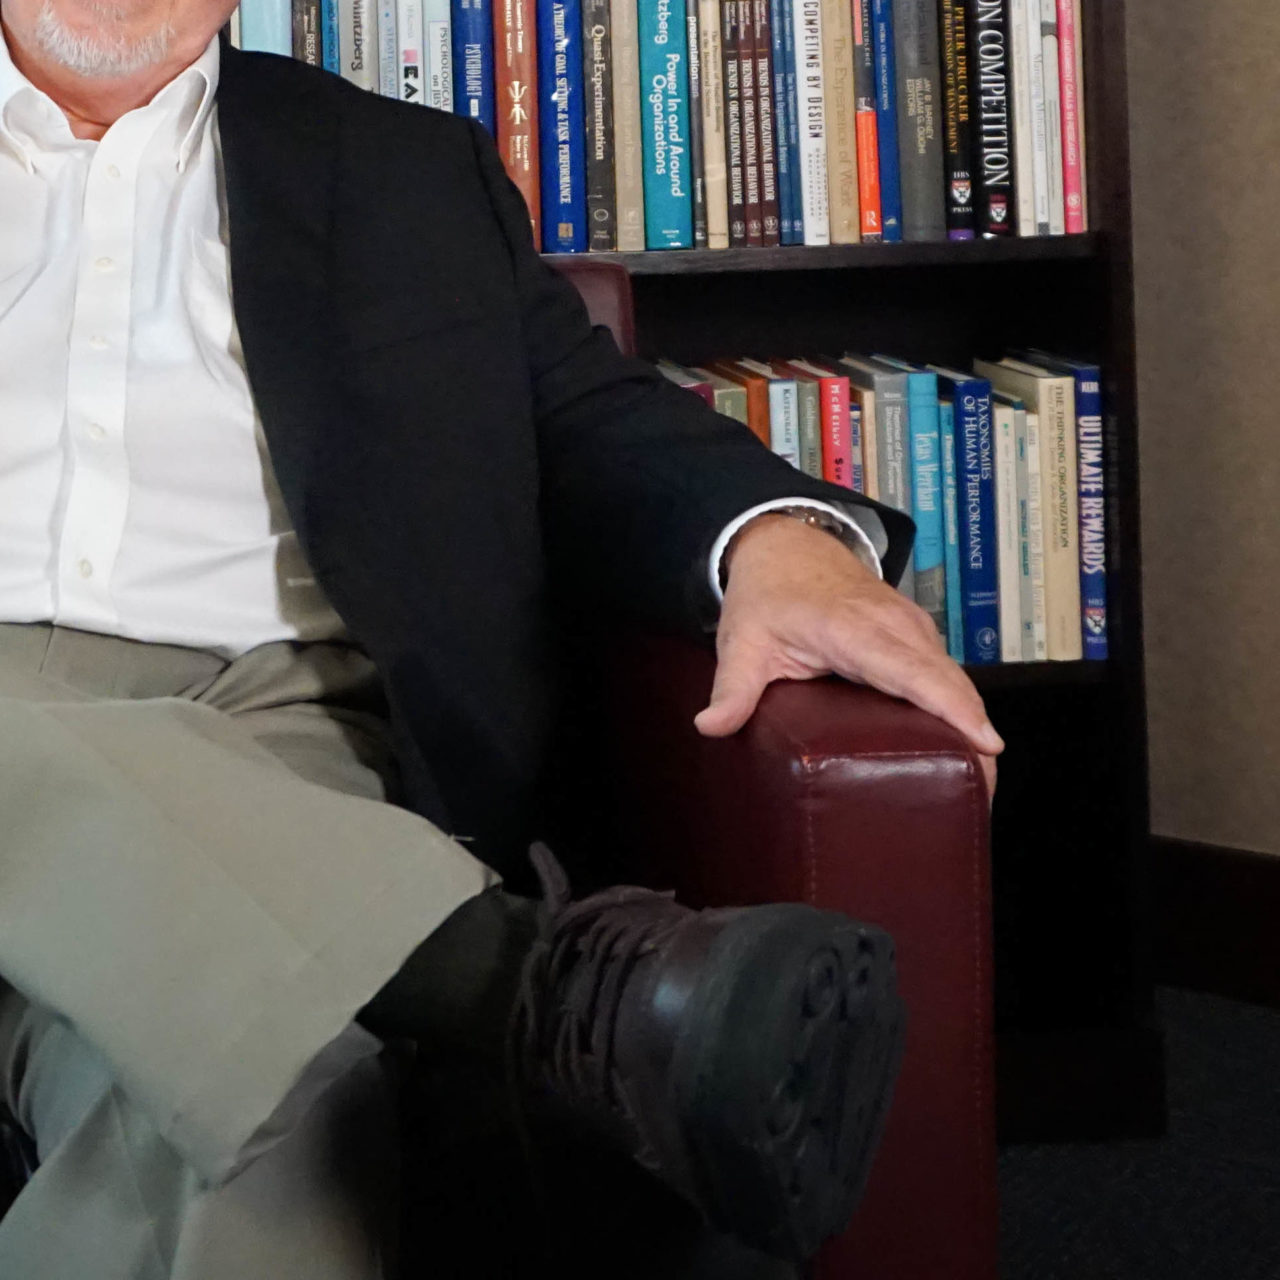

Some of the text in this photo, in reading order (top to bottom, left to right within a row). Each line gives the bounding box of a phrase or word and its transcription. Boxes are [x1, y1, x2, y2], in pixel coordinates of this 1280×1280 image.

[465, 44, 482, 96] PSYCHOLOGY
[554, 9, 566, 42] THEORY
[556, 55, 568, 75] GOAL
[804, 2, 822, 138] COMPETING BY DESIGN
[955, 7, 968, 122] PETER DRUCKER
[557, 78, 568, 111] SETTING
[558, 120, 569, 141] TASK
[592, 24, 605, 160] Quasi-Experimentation
[650, 75, 667, 174] Organizations
[666, 54, 684, 196] Power In and Around
[759, 58, 775, 200] TRENDS IN ORGANIZATIONAL BEHAVIOR
[834, 36, 851, 206] The Experience of Work
[979, 30, 1010, 185] COMPETITION
[559, 144, 570, 203] PERFORMANCE
[806, 396, 815, 438] Goldman
[978, 395, 991, 479] TAXONOMIES
[1055, 386, 1069, 547] THE THINKING ORGANIZATION
[915, 432, 939, 511] Texas Merchant
[963, 395, 982, 569] OF HUMAN PERFORMANCE
[1078, 415, 1105, 574] ULTIMATE REWARDS
